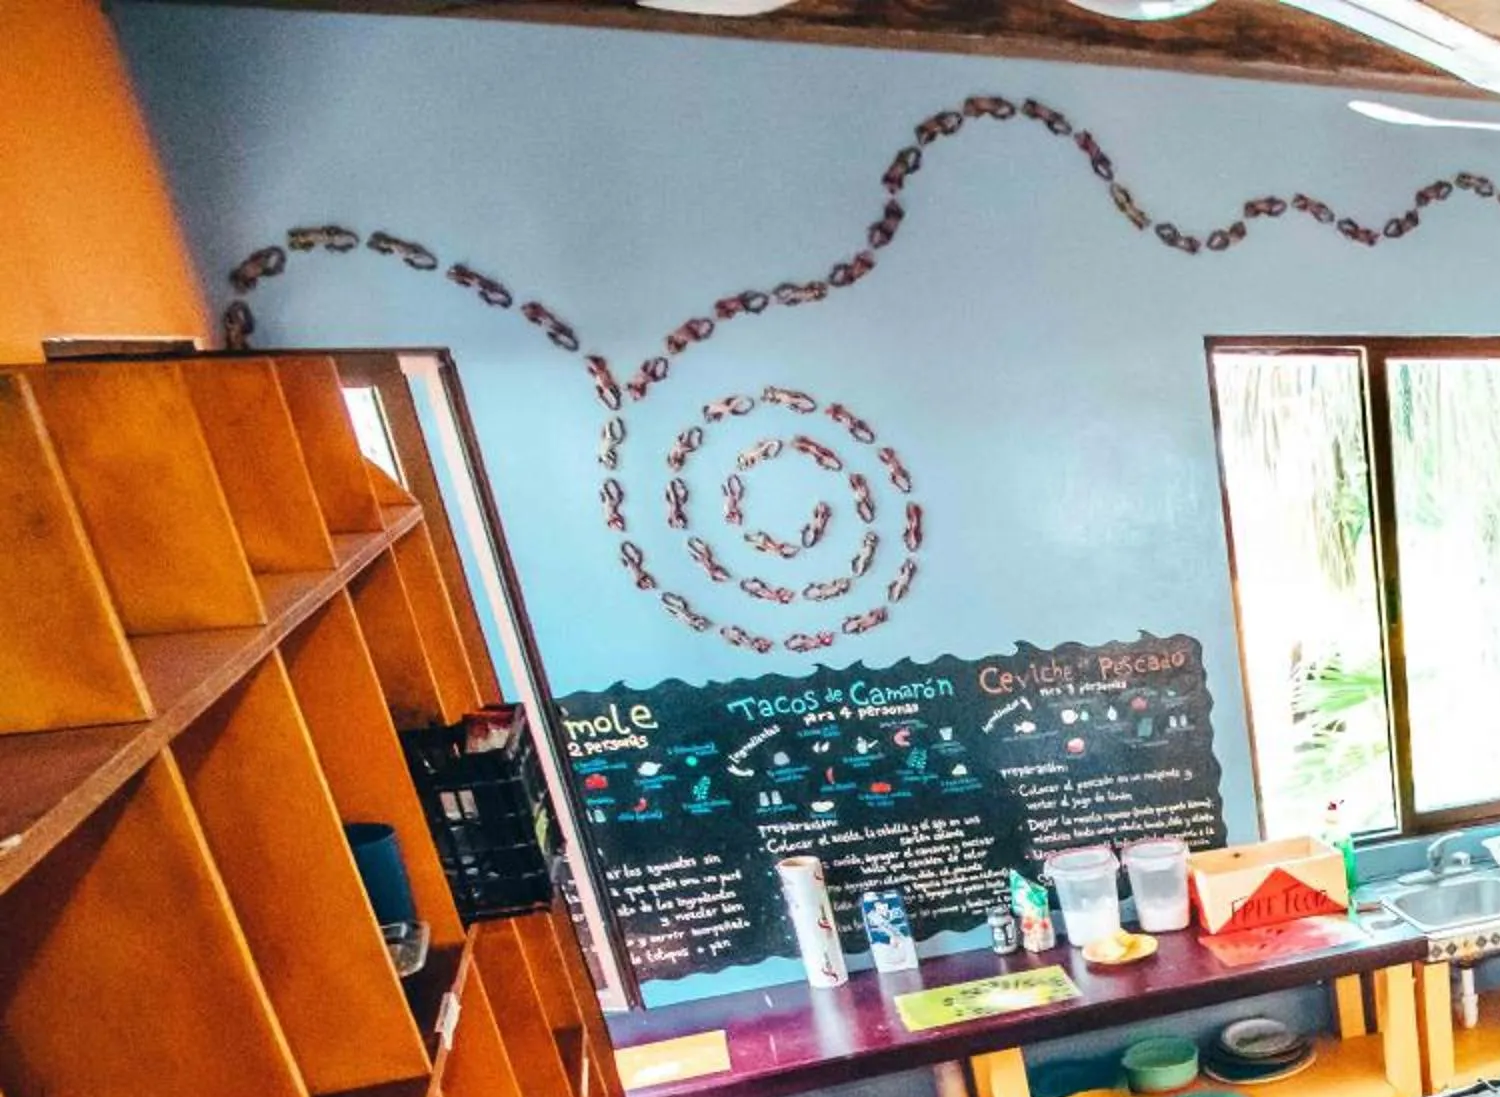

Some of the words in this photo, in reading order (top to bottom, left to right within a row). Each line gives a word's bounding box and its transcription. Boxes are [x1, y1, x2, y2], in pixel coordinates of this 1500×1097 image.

[979, 660, 1072, 694] Ceviche
[1100, 651, 1186, 679] Pescado
[727, 690, 820, 720] Tacos
[824, 688, 843, 703] de
[850, 677, 954, 706] Camarón
[563, 703, 659, 740] mole
[803, 708, 835, 725] para
[839, 706, 853, 719] 4
[858, 703, 919, 720] personas
[567, 743, 583, 757] 2
[767, 838, 813, 854] Colocar
